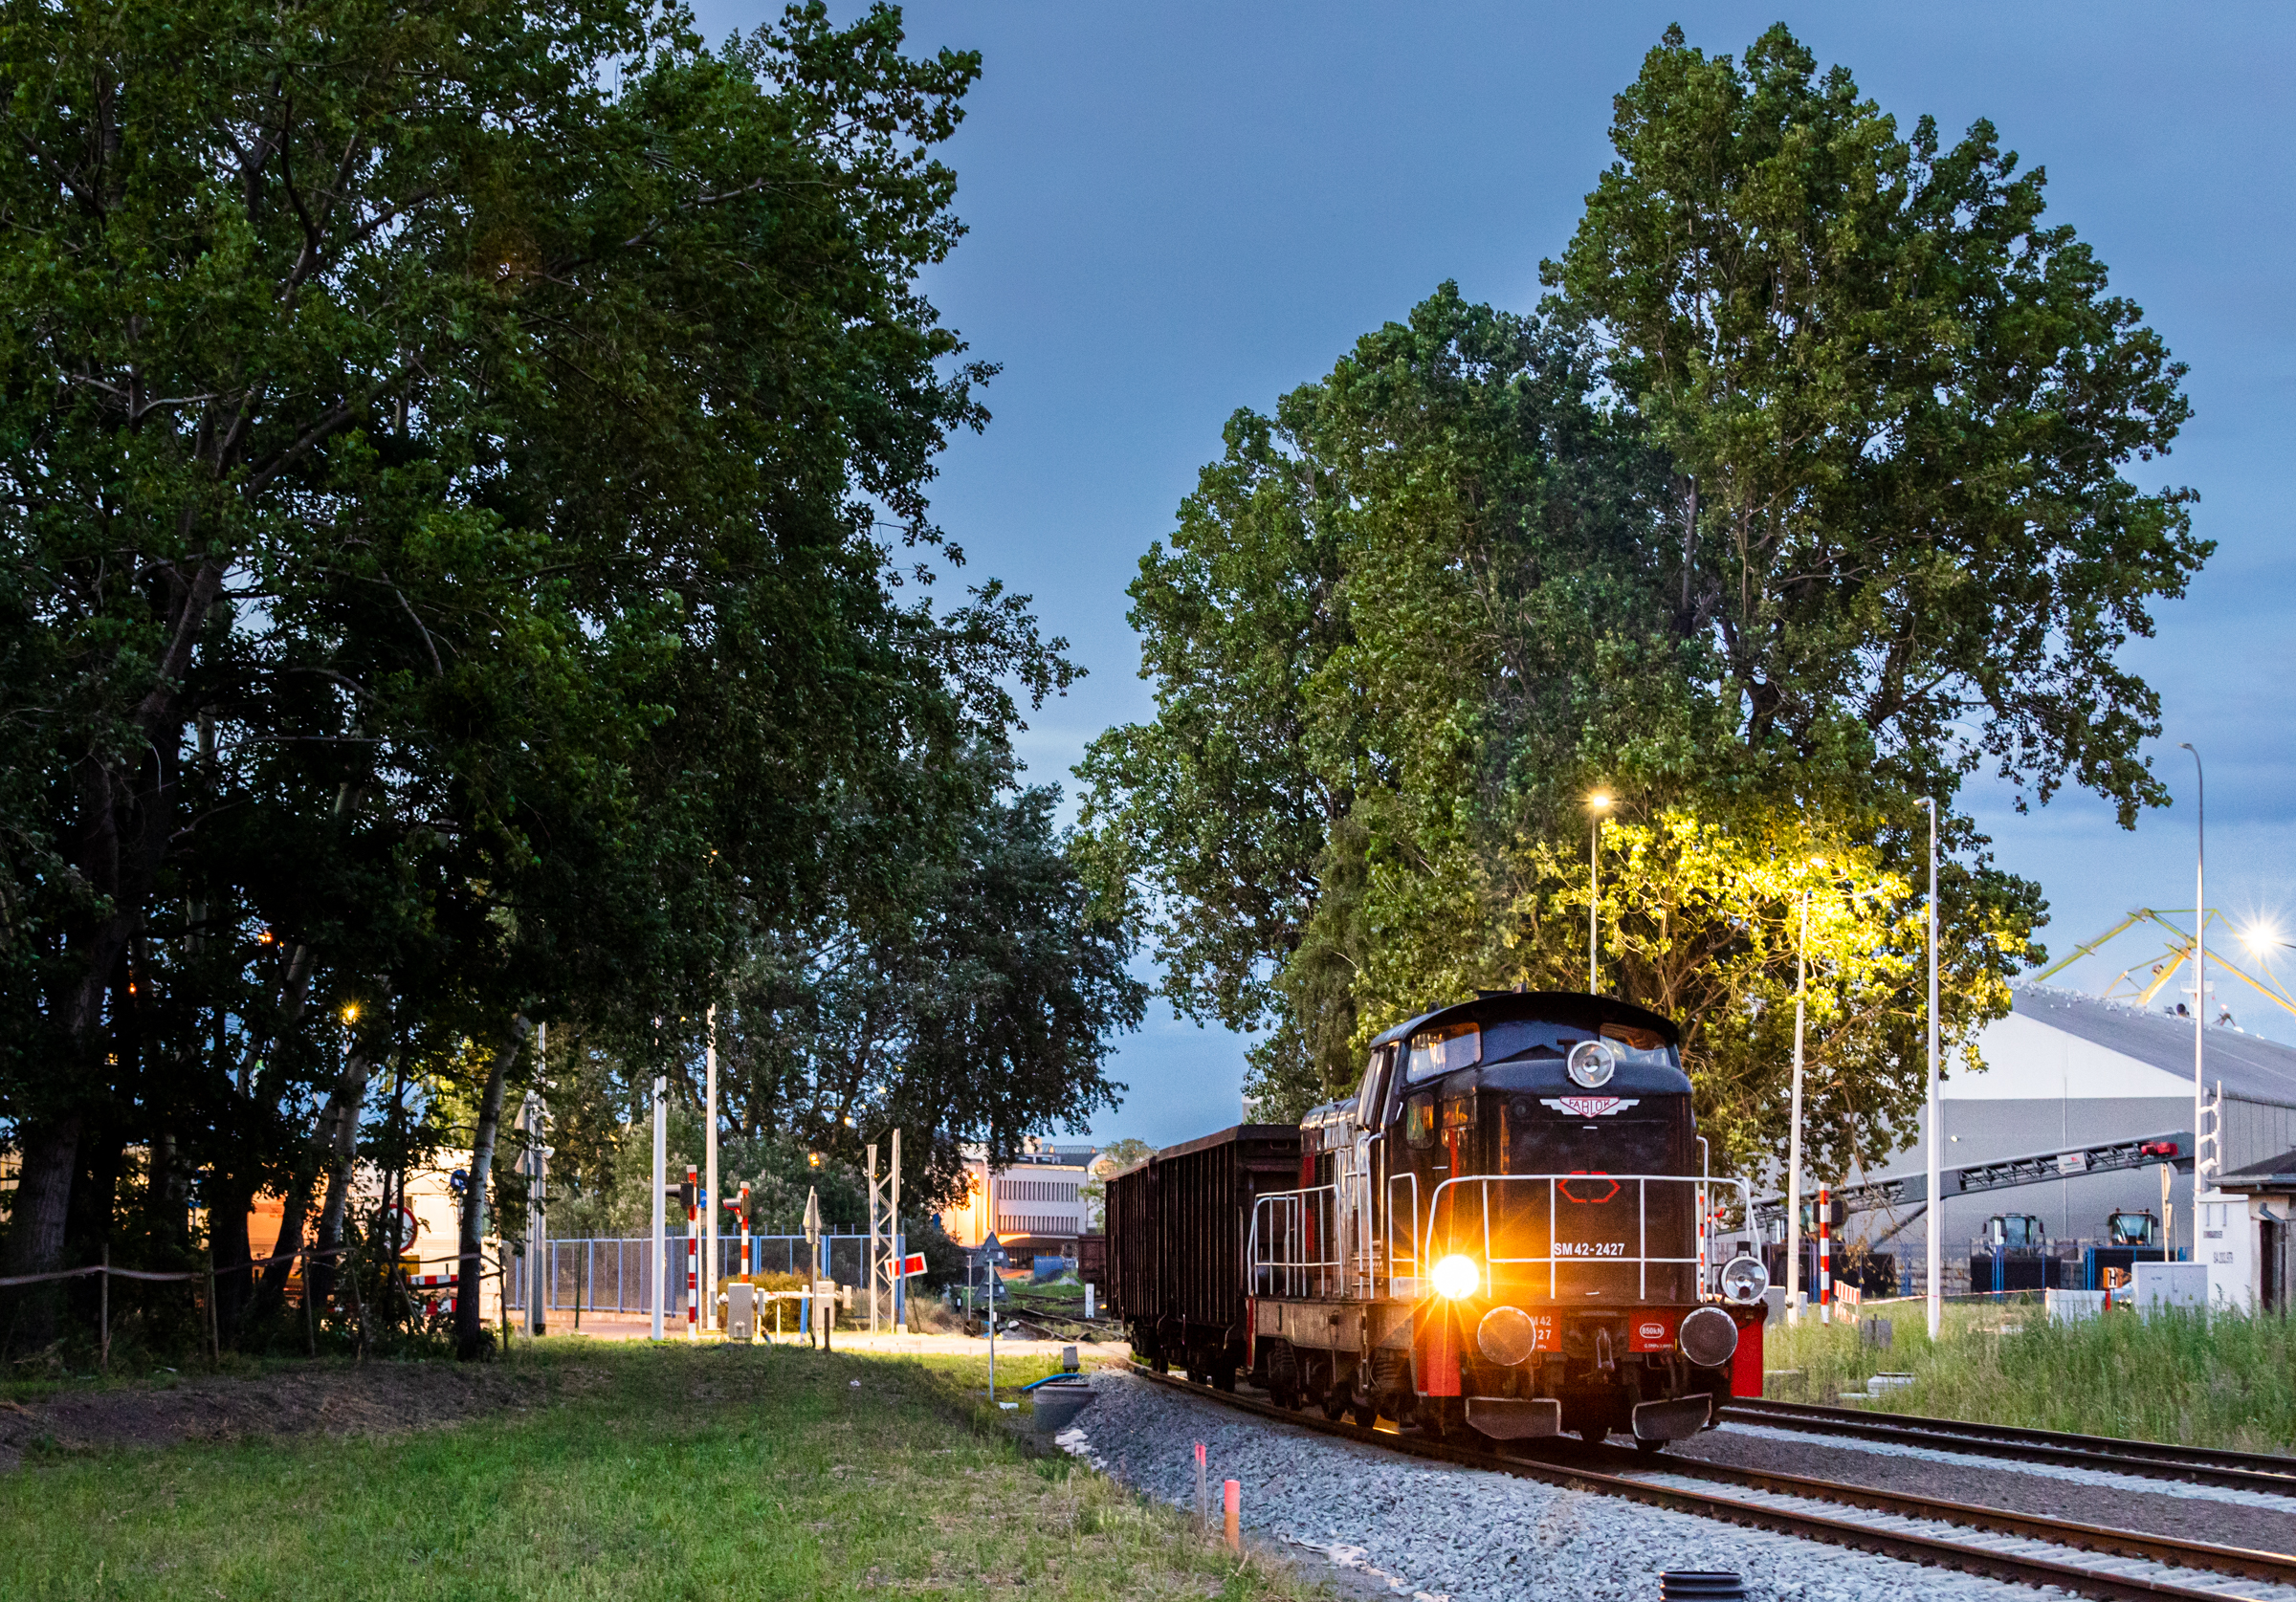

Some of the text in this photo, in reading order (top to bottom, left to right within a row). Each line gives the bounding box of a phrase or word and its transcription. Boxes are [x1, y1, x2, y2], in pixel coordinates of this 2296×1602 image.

[1569, 1099, 1610, 1115] FABLOK
[1537, 1329, 1552, 1340] 27
[1642, 1327, 1662, 1335] 850kN
